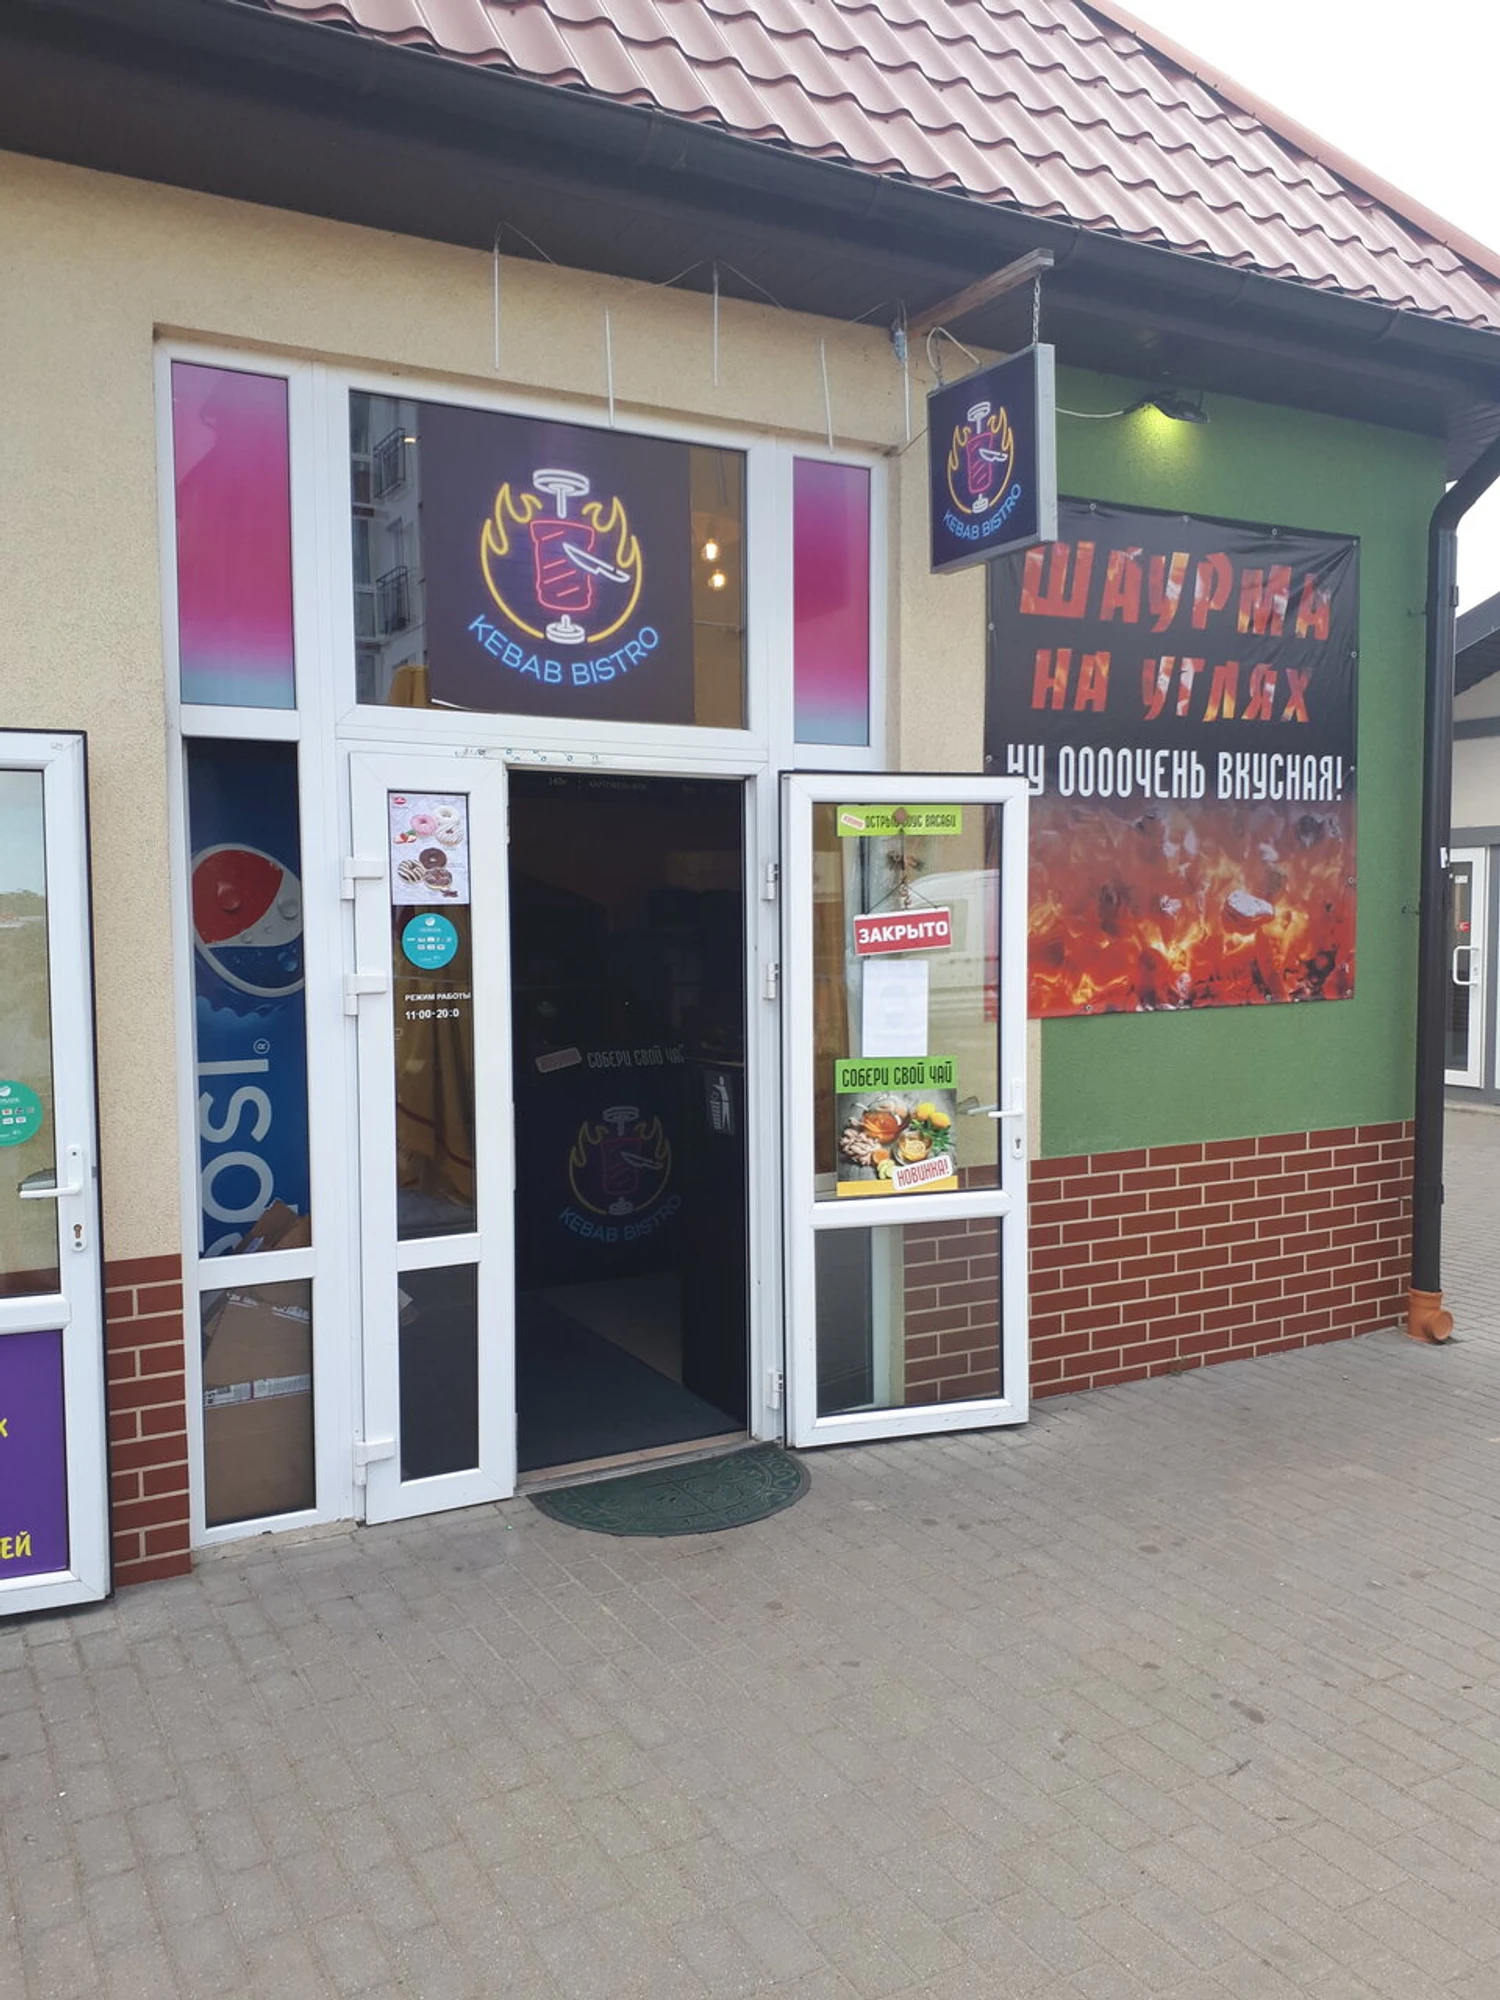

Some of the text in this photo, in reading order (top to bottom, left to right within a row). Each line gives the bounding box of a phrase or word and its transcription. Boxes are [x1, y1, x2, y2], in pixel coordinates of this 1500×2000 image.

[943, 484, 1021, 539] KEBAB BISTRO
[1019, 541, 1332, 640] ШАУРМА
[468, 614, 659, 686] KEBAB BISTRO
[1031, 648, 1313, 723] НА УГЛЯХ
[1007, 744, 1343, 802] НУ ООООЧЕНЬ ВКУСНАЯ!
[858, 921, 948, 944] ЗАКРЫТО
[404, 992, 471, 1002] РЕЖИМ РАБОТЫ
[587, 1050, 631, 1069] СОБЕРИ
[634, 1045, 663, 1066] СВОЙ
[842, 1061, 953, 1088] СОБЕРИ СВОЙ ЧАЙ
[896, 1159, 949, 1188] НОВИНКА!
[559, 1194, 682, 1244] KEBAB BISTRO
[0, 1531, 32, 1560] ЕЙ
